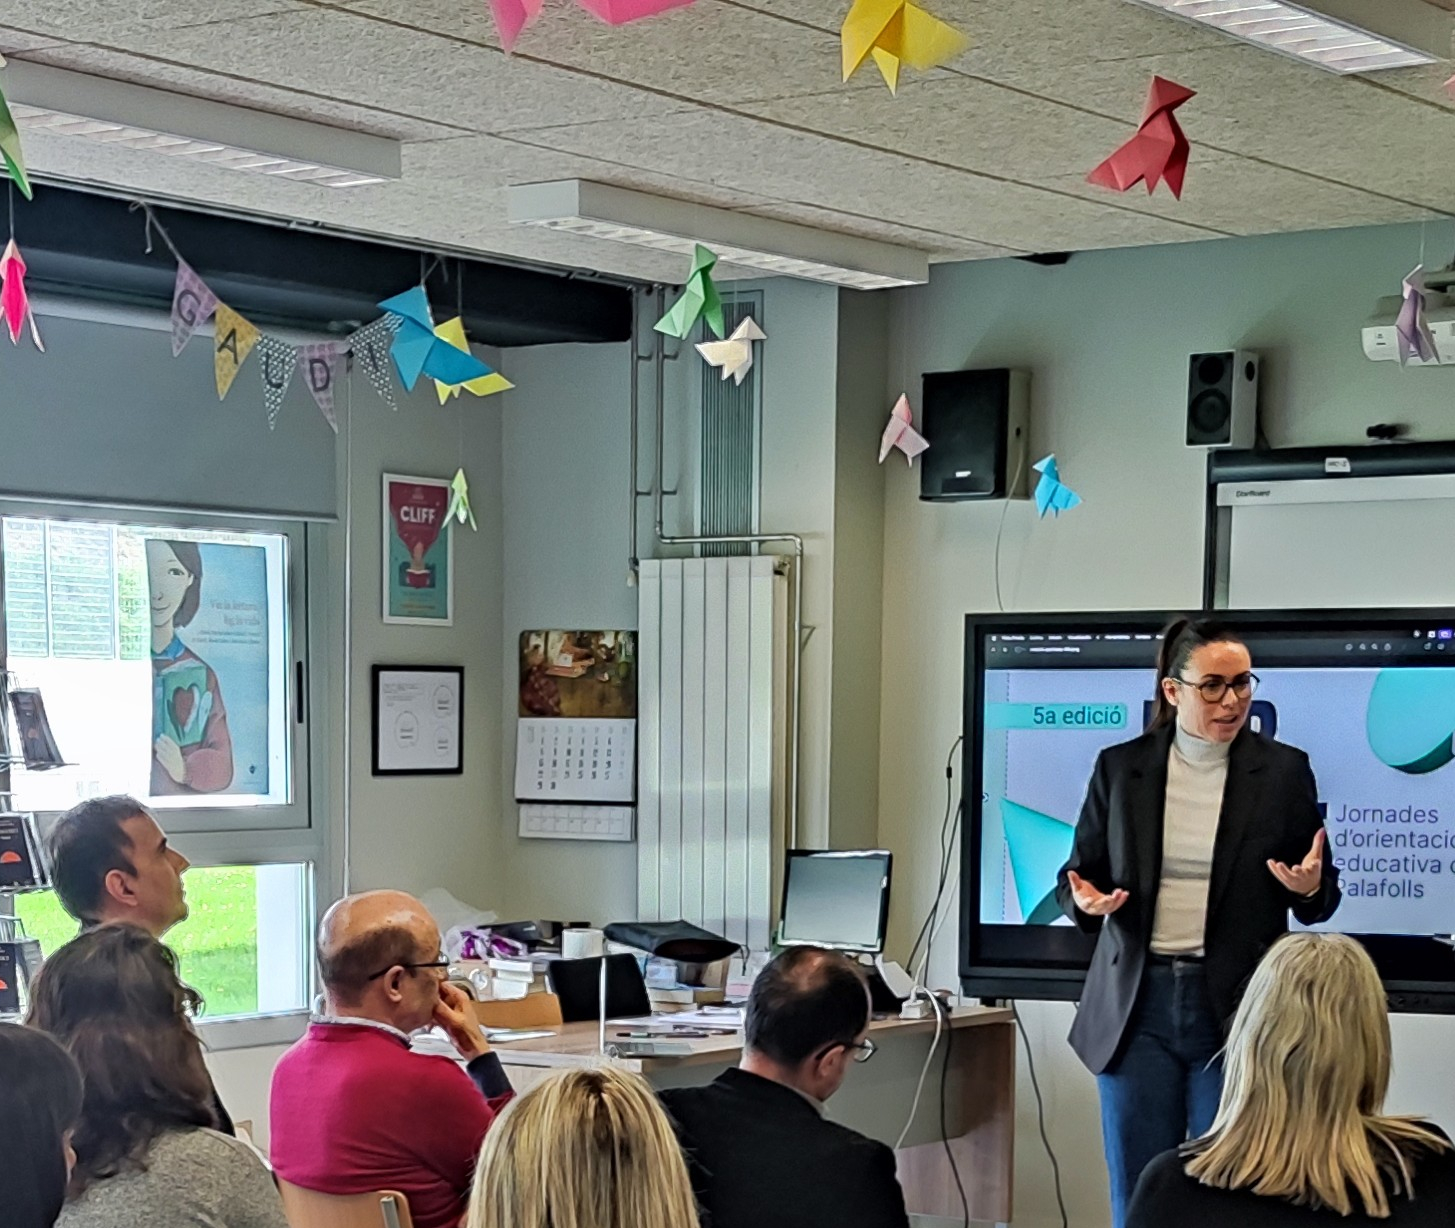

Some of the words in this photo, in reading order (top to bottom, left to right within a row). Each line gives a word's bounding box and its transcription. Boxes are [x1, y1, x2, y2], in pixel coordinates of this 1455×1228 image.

[400, 505, 437, 525] CLIFF
[1032, 706, 1056, 725] 5a
[1062, 705, 1122, 725] edició
[1335, 804, 1439, 824] Jornades
[1334, 853, 1441, 874] educativa
